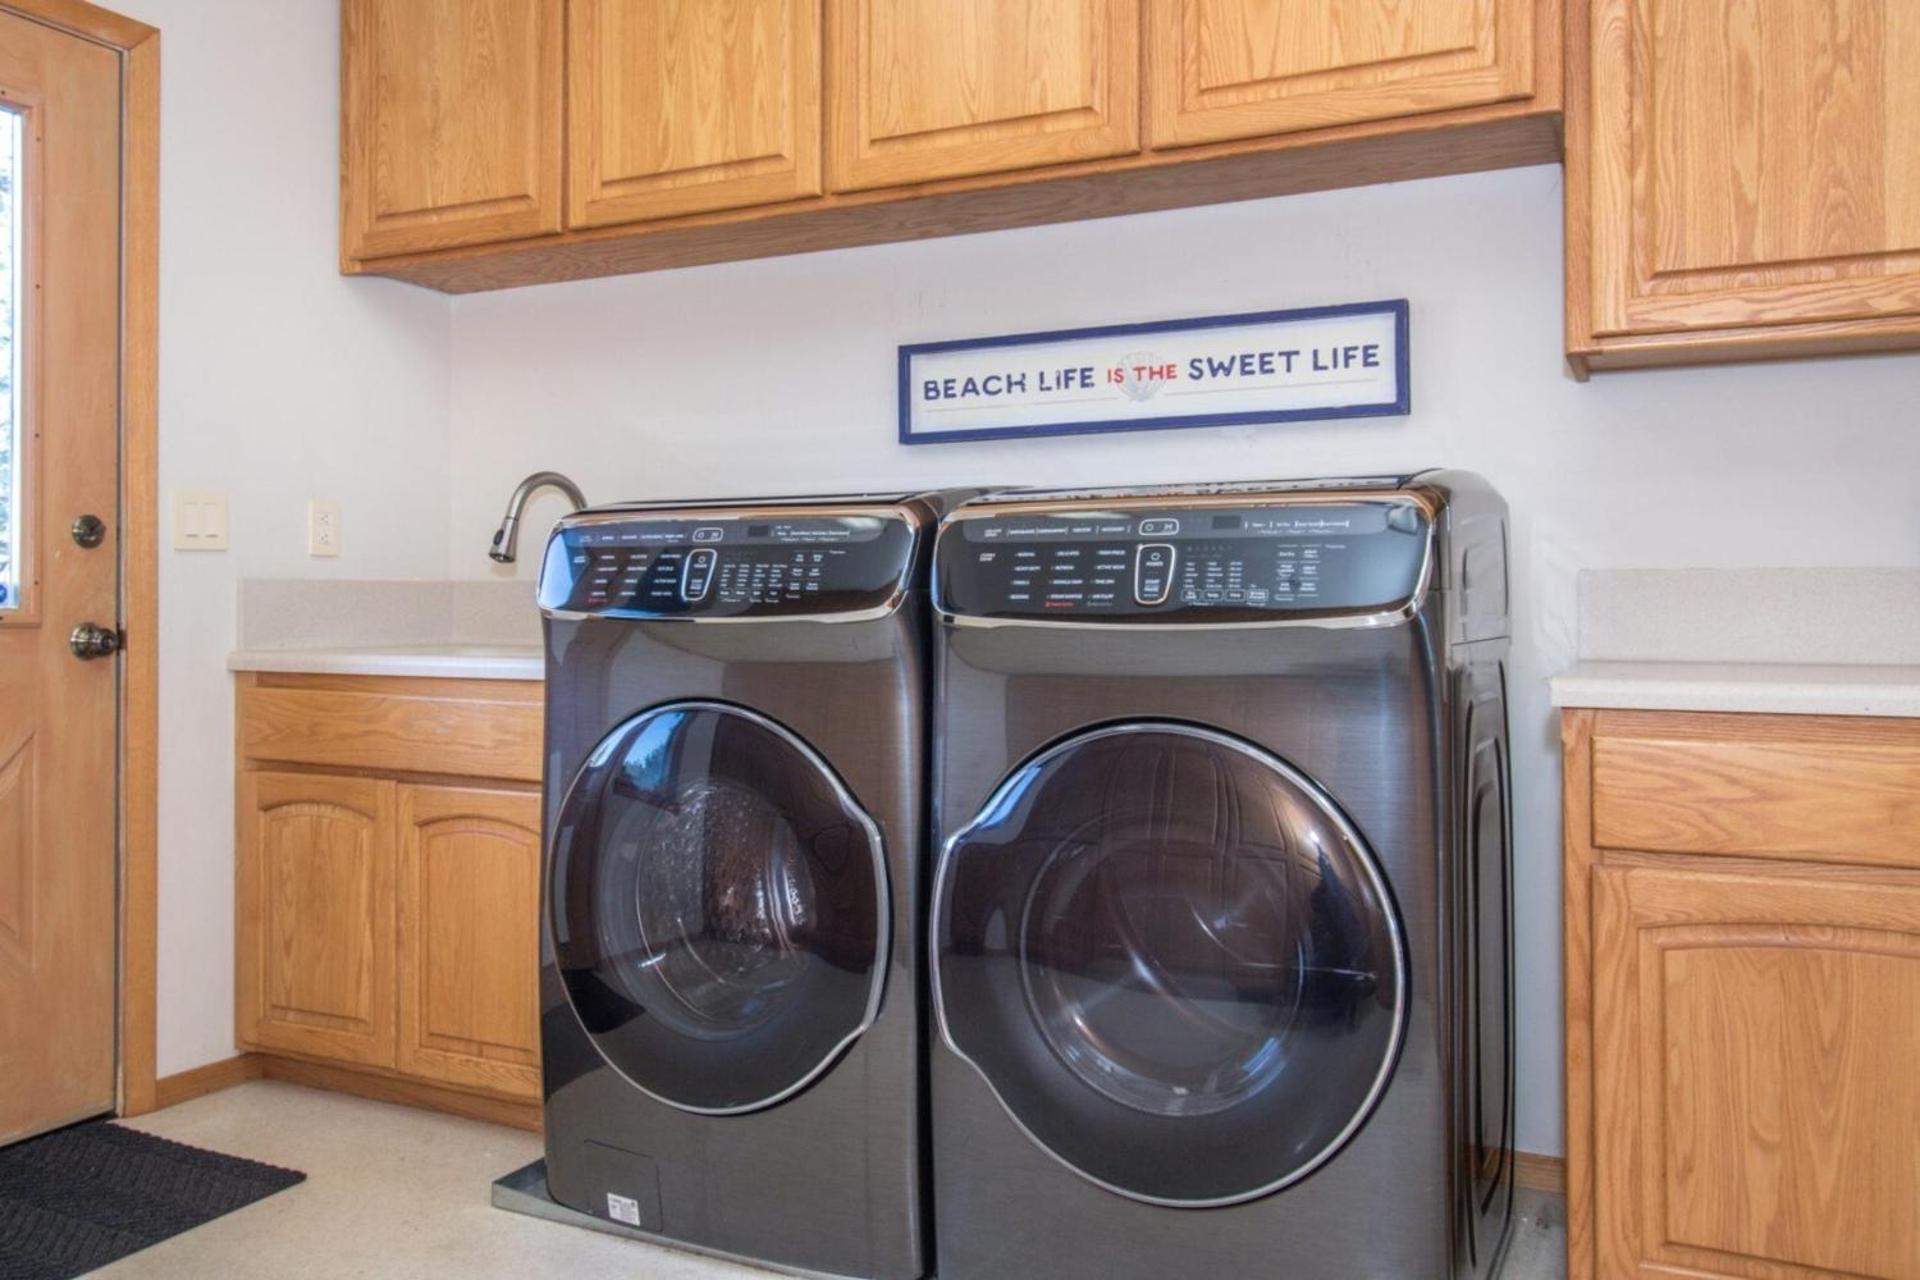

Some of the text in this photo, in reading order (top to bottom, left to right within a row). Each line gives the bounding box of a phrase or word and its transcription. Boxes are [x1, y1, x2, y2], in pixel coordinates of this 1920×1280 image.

[923, 344, 1380, 401] BEACH LIFE IS THE SWEET LIFE
